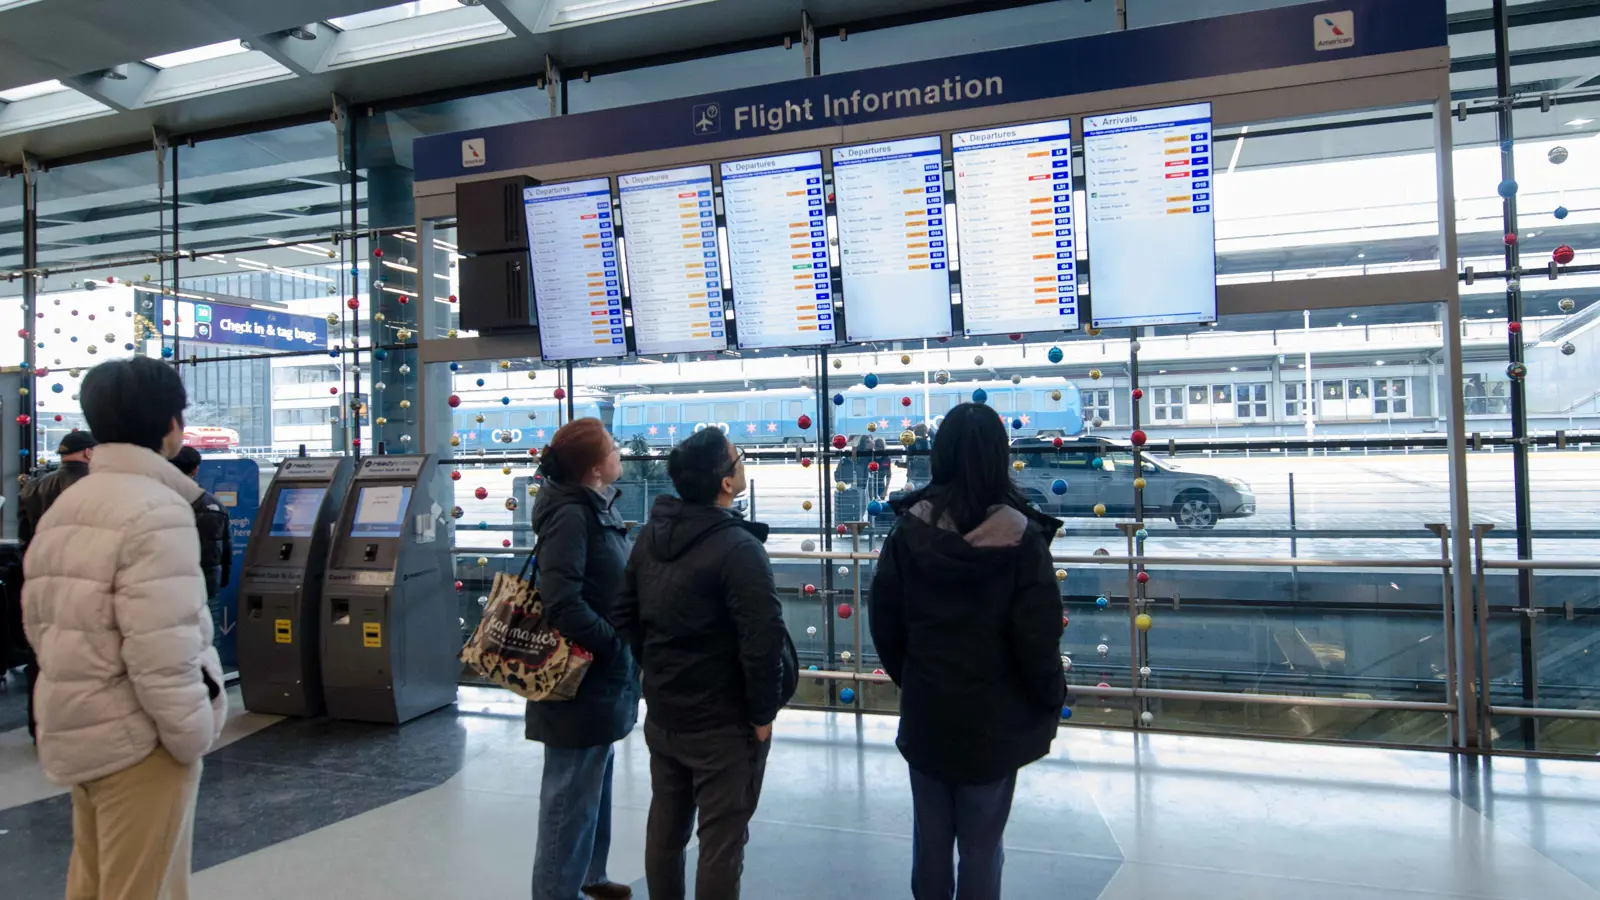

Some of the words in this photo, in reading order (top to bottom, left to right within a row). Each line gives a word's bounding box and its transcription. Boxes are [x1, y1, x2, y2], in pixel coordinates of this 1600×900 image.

[1318, 37, 1352, 46] American
[734, 99, 813, 131] Flight
[824, 75, 1003, 118] Information
[1103, 114, 1138, 126] Arrivals
[970, 131, 1016, 142] Departures
[848, 146, 891, 157] Departures
[735, 160, 776, 171] Departures
[632, 174, 669, 184] Departures
[535, 186, 571, 197] Departures
[219, 319, 252, 333] Check
[254, 322, 265, 335] in
[266, 325, 276, 336] &
[277, 326, 293, 342] tag
[295, 326, 317, 344] bags
